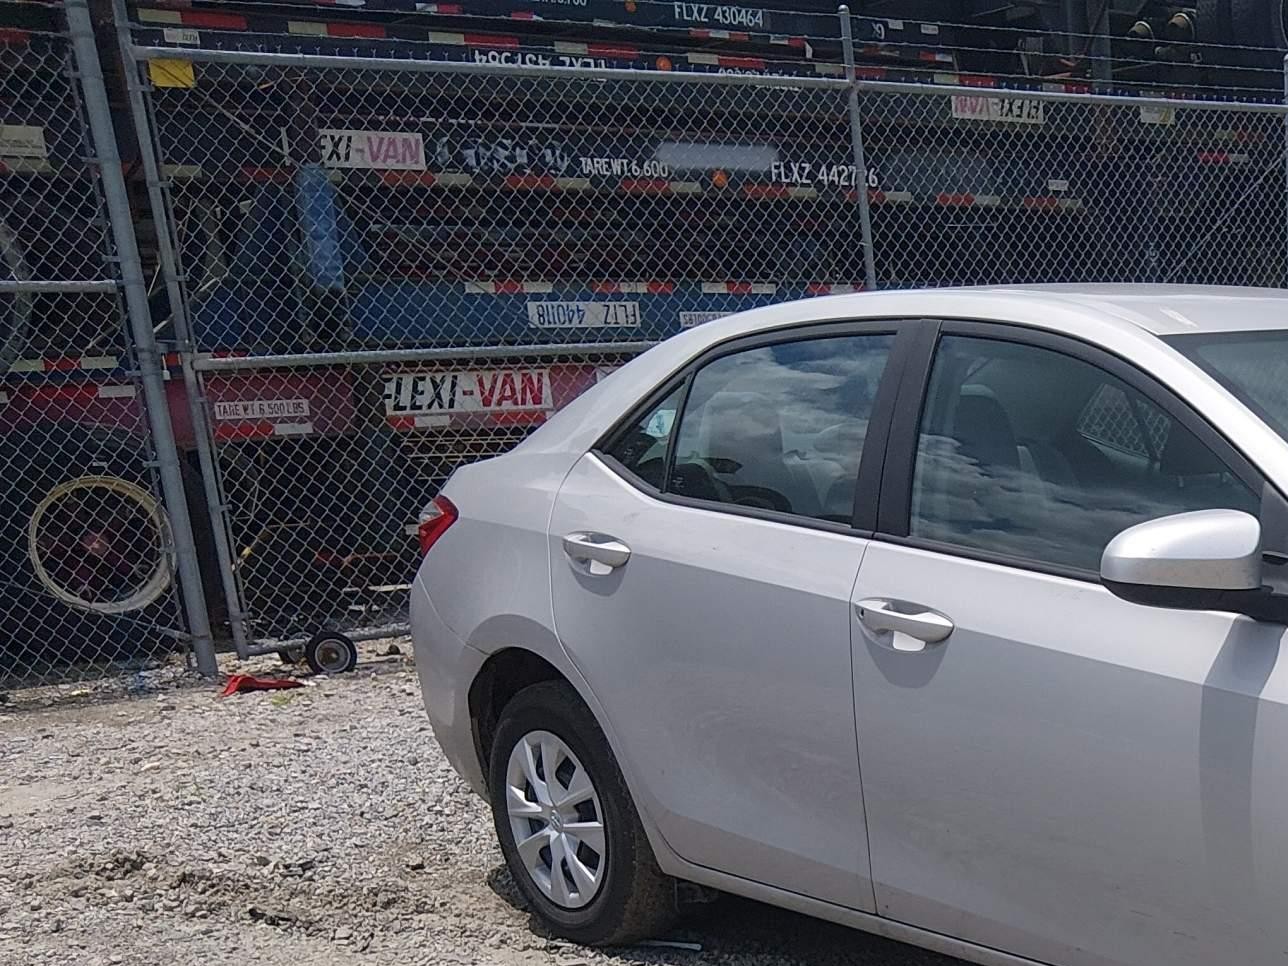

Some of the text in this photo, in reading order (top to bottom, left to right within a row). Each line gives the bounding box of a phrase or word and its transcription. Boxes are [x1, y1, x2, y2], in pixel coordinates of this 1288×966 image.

[673, 3, 763, 28] FLXZ 430464
[771, 161, 878, 187] FLXZ 44276
[603, 303, 638, 325] FLTZ
